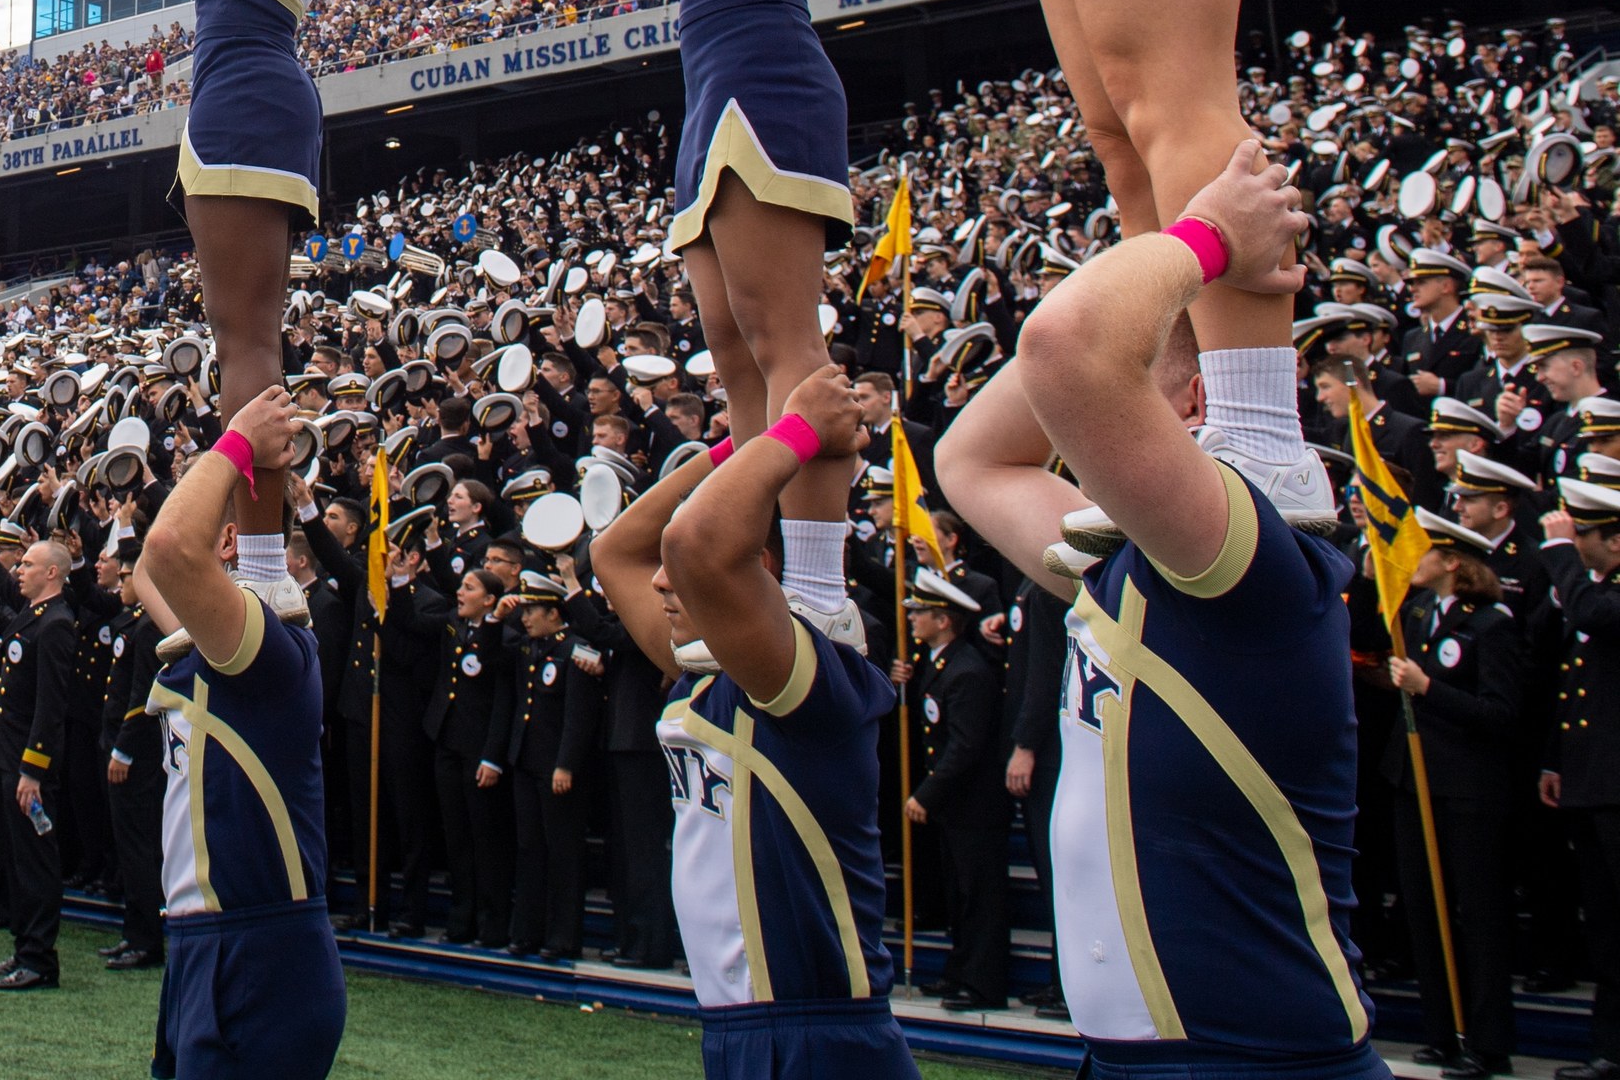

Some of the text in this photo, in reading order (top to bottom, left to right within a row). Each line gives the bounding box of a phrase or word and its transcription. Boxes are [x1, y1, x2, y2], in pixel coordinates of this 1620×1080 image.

[410, 57, 490, 91] CUBAN
[503, 33, 611, 74] MISSILE
[3, 128, 143, 171] 38TH PARALLEL
[310, 242, 321, 258] V
[348, 238, 359, 255] Y
